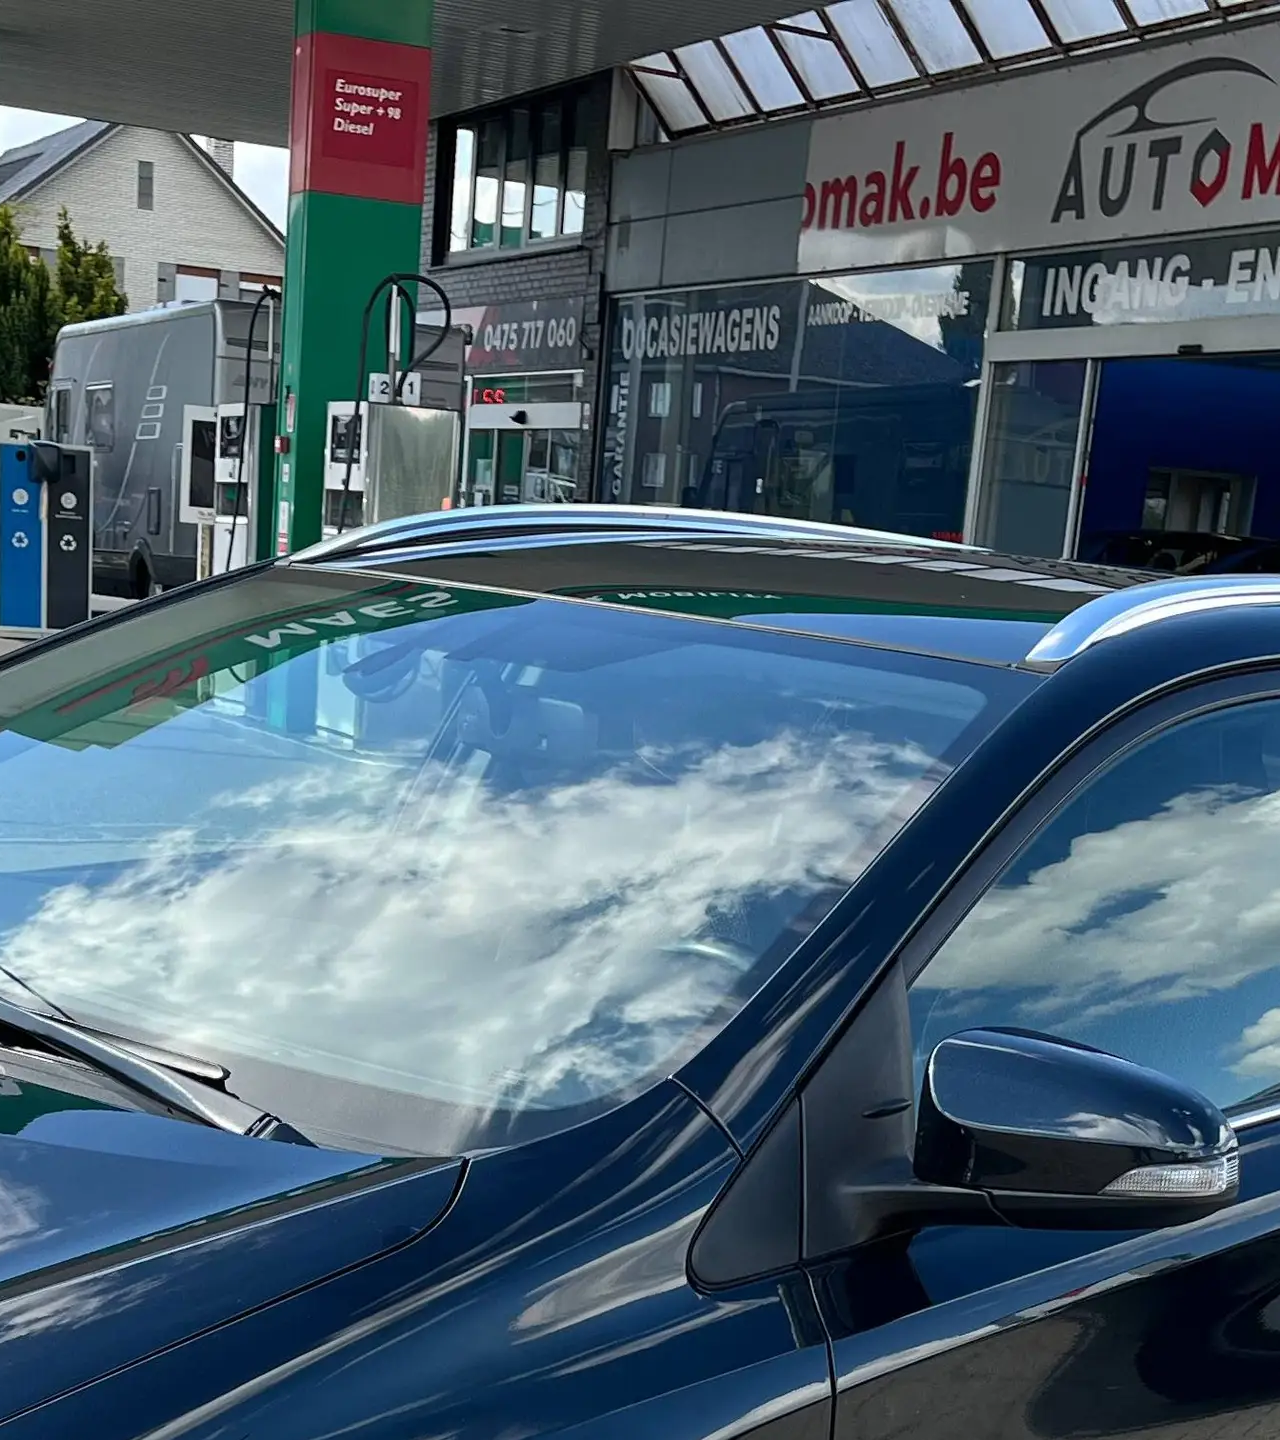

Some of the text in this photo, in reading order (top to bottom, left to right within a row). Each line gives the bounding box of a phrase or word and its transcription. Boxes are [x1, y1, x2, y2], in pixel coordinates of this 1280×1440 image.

[335, 78, 402, 102] Eurosuper
[334, 97, 374, 116] Super
[387, 106, 402, 120] 98
[333, 117, 374, 136] Diesel
[1042, 253, 1190, 317] INGANG
[483, 316, 576, 352] 0475 717 060
[380, 380, 413, 395] 2 1
